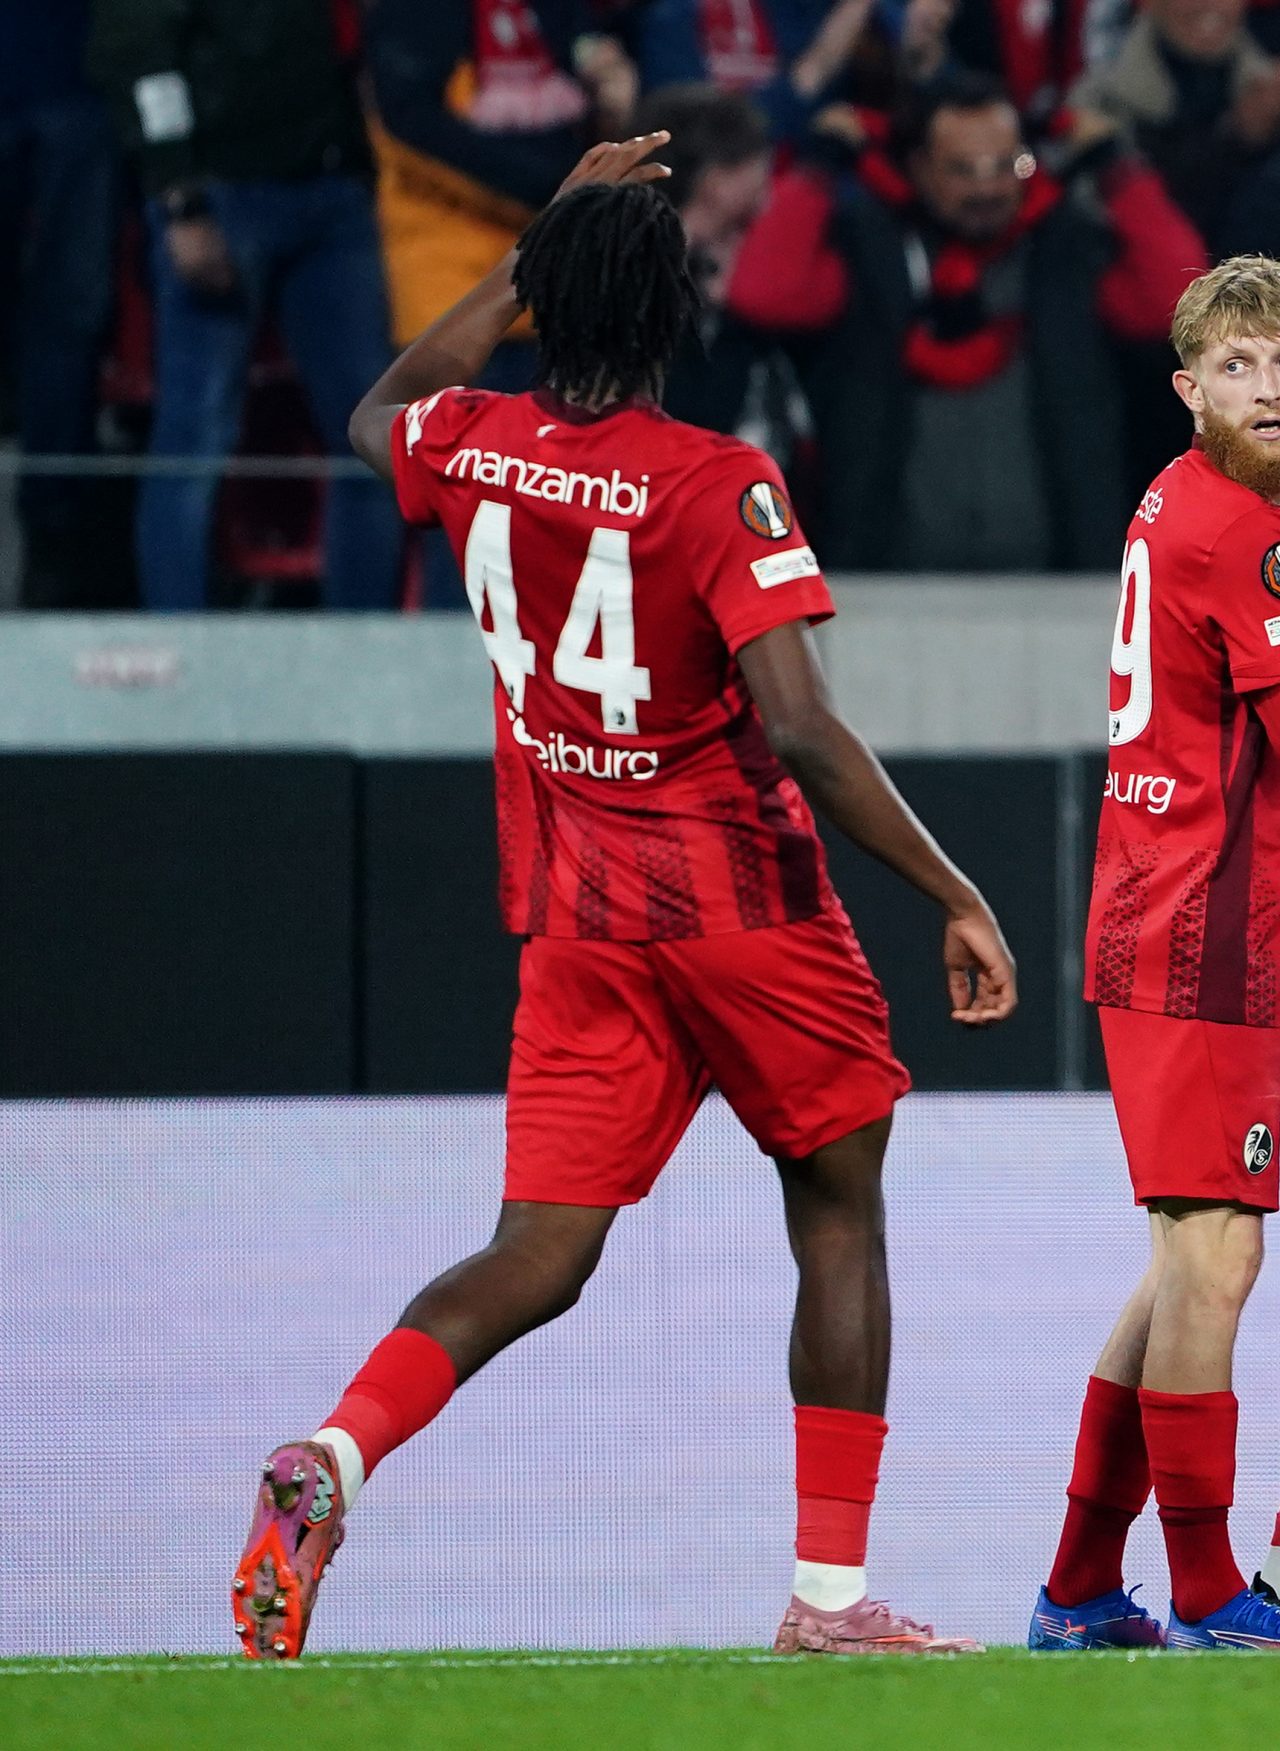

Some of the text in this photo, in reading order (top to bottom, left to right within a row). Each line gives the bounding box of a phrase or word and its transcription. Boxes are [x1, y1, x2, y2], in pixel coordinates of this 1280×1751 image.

[444, 448, 650, 518] manzambi
[464, 499, 652, 735] 44
[1108, 537, 1153, 747] 9
